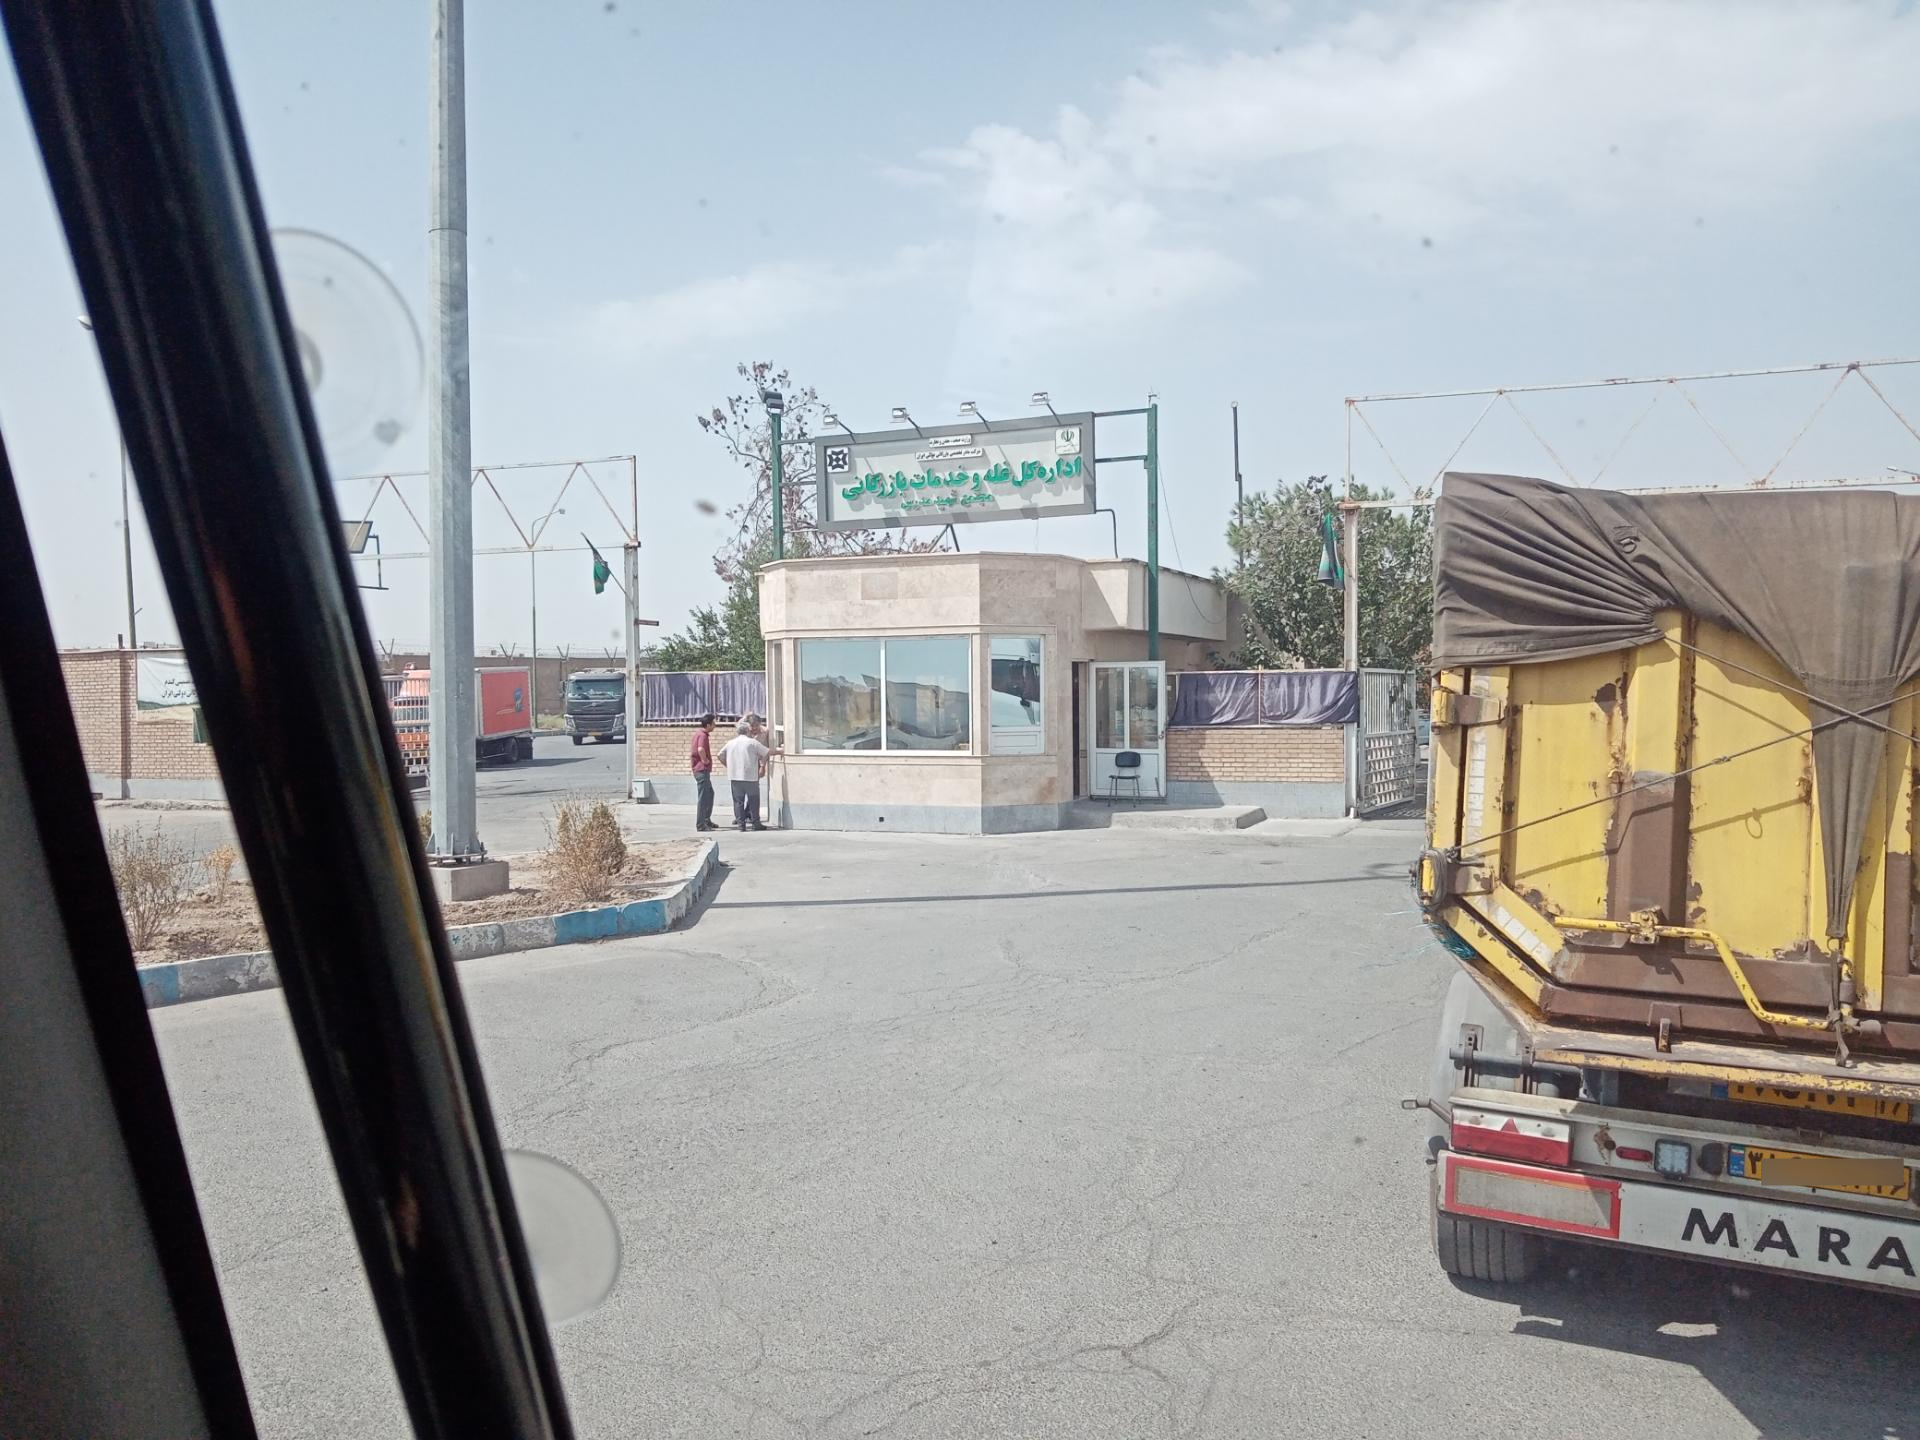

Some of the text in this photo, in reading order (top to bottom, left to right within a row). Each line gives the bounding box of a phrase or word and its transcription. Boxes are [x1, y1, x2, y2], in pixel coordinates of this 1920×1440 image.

[841, 455, 1082, 500] اداره کل غله و خدمات بازرگانی
[1681, 1208, 1916, 1277] MARA
